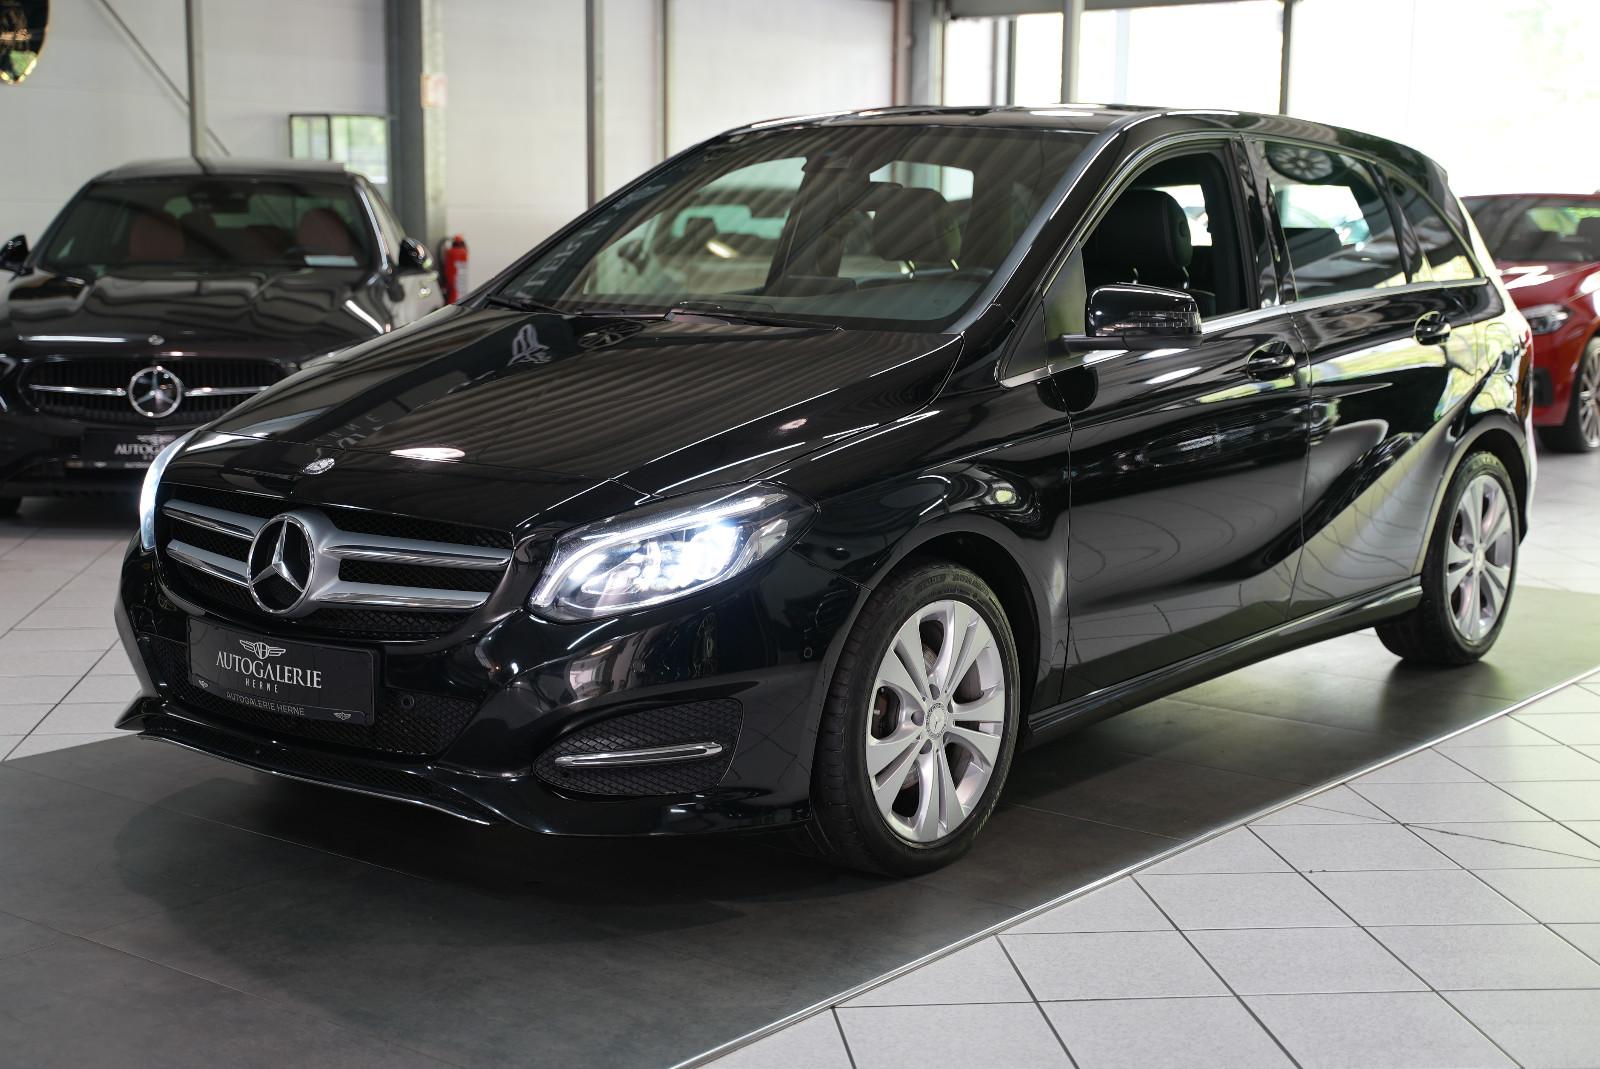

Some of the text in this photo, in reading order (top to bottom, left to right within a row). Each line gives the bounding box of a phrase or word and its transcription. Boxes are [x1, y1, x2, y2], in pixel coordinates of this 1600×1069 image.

[216, 651, 322, 689] AUTOGALERIE
[245, 678, 279, 693] HERNE
[226, 691, 305, 716] AUTOGALERIE HERNE
